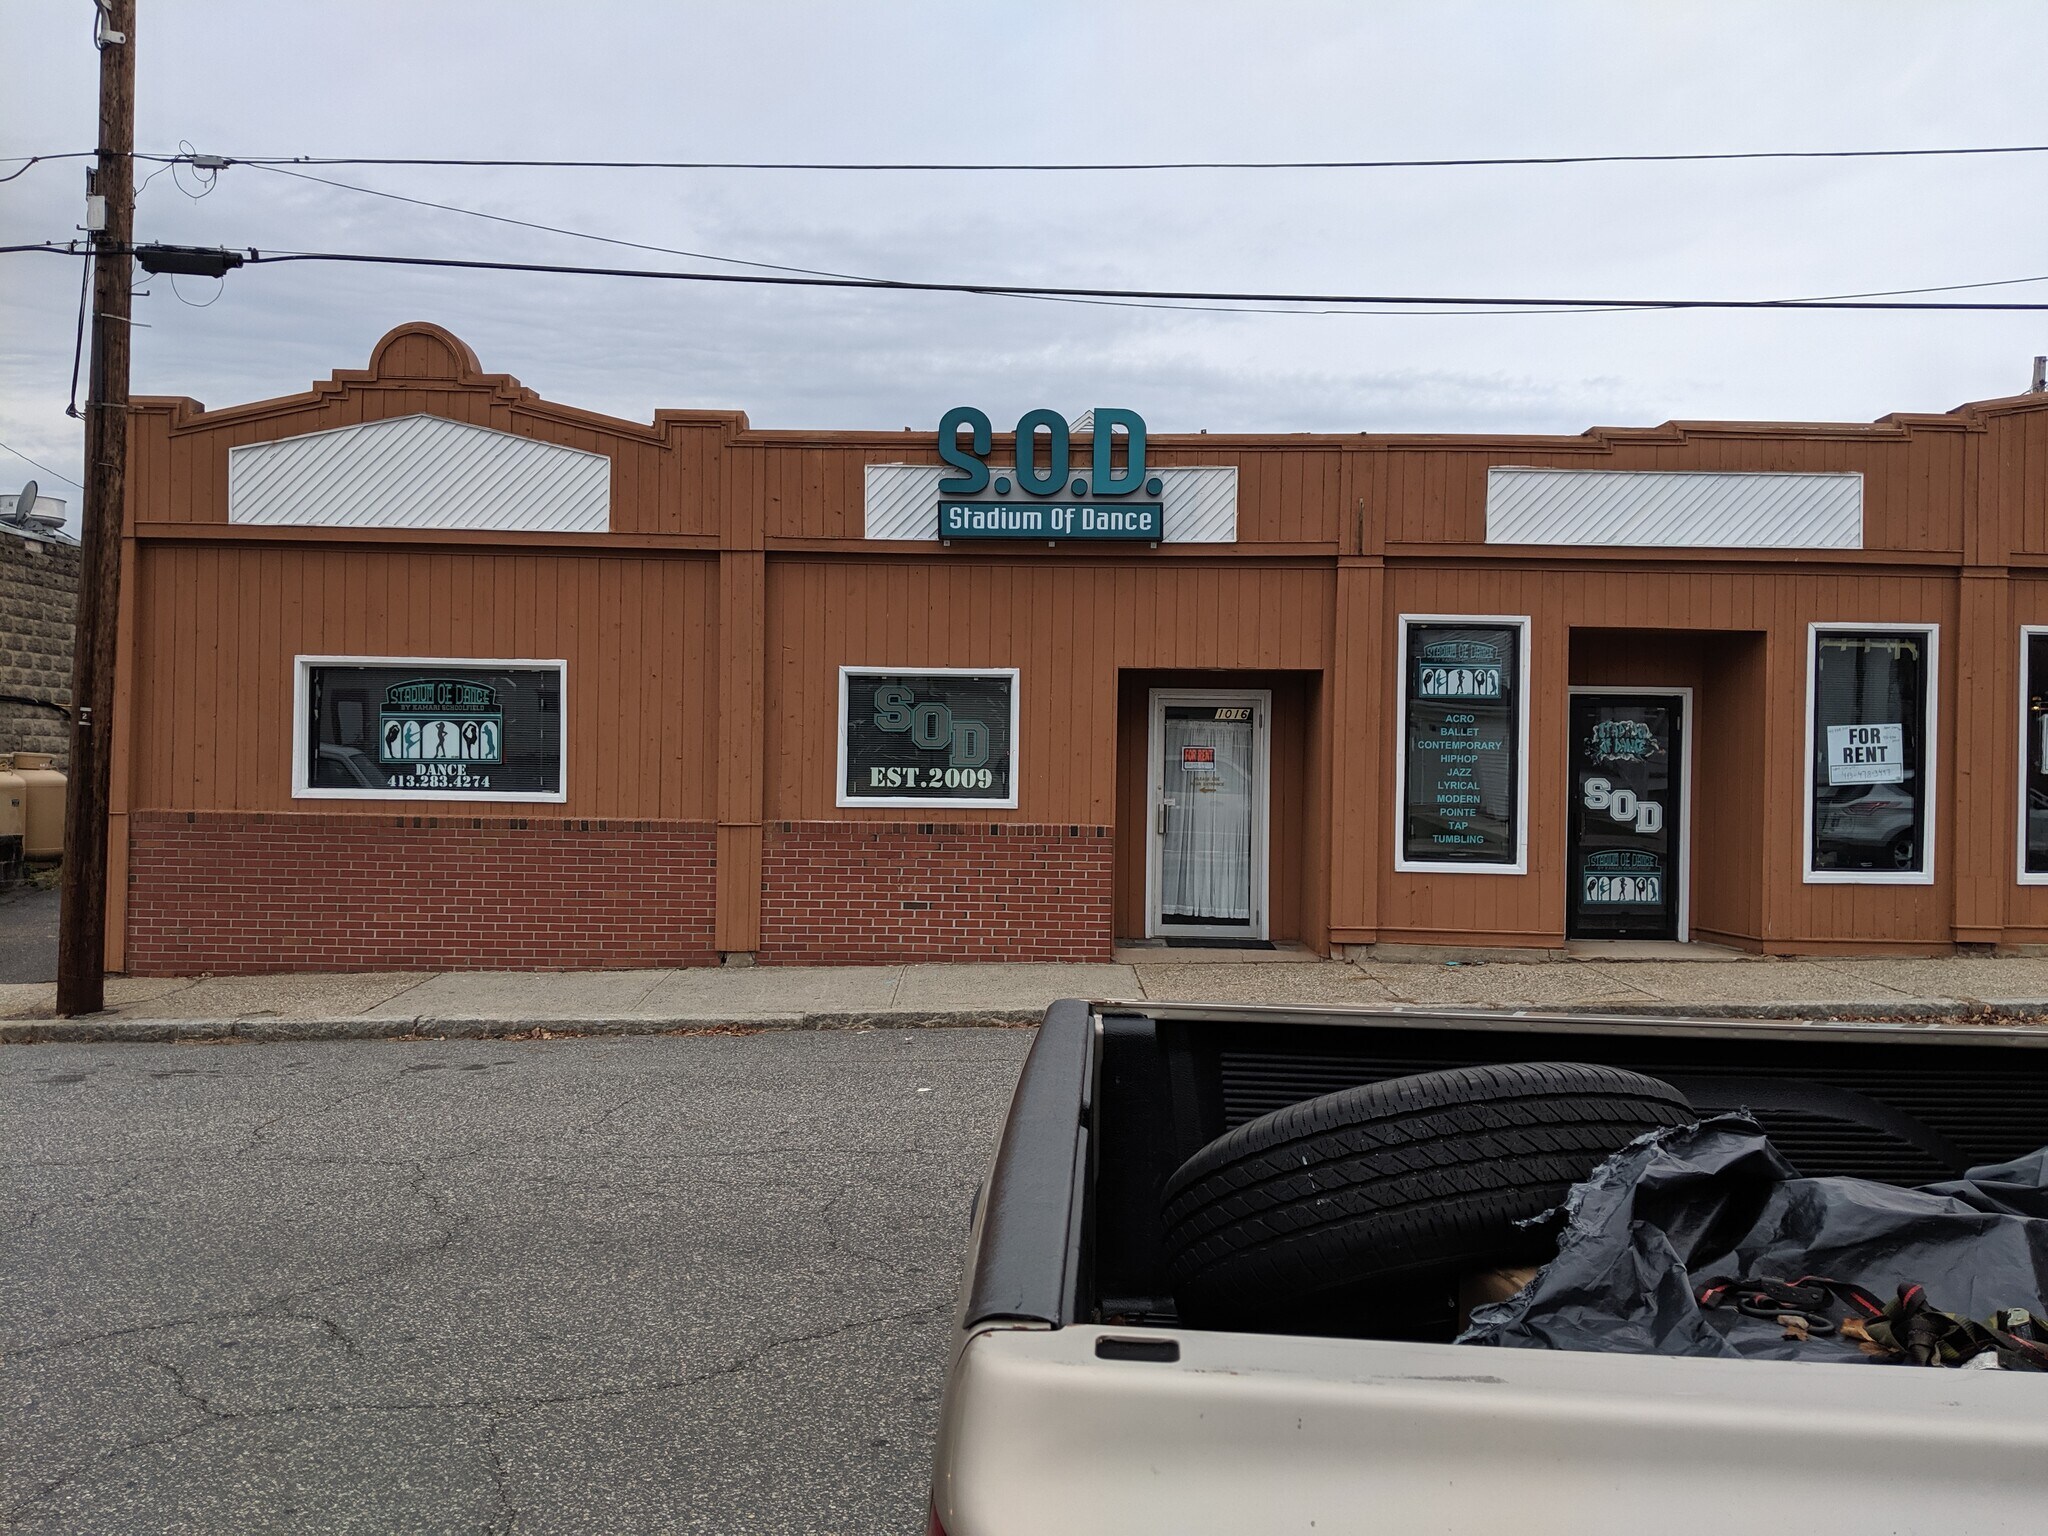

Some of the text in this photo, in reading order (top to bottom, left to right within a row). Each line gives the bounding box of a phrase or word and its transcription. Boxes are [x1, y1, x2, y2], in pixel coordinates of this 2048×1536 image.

[938, 406, 1163, 497] S.O.D.
[950, 507, 1152, 534] Stadium Of Dance
[390, 683, 435, 704] STADIUM
[455, 684, 490, 705] DANCE
[82, 712, 88, 720] 2
[1218, 709, 1249, 719] 1016
[1445, 714, 1475, 723] ACRO
[873, 685, 990, 768] SOD
[1440, 728, 1480, 736] BALLET
[1849, 728, 1881, 745] FOR
[1417, 741, 1502, 750] CONTEMPORARY
[1184, 749, 1213, 762] FOR RENT
[1440, 755, 1478, 763] HIPHOP
[1843, 746, 1888, 764] RENT
[415, 764, 467, 776] DANCE
[1447, 768, 1472, 777] JAZZ
[387, 775, 491, 788] 413.283.4274
[870, 767, 993, 789] EST.2009
[1437, 781, 1480, 790] LYRICAL
[1436, 794, 1481, 804] MODERN
[1584, 777, 1663, 834] SOD
[1440, 808, 1477, 817] POINTE
[1448, 821, 1469, 830] TAP
[1432, 834, 1485, 844] TUMBLING
